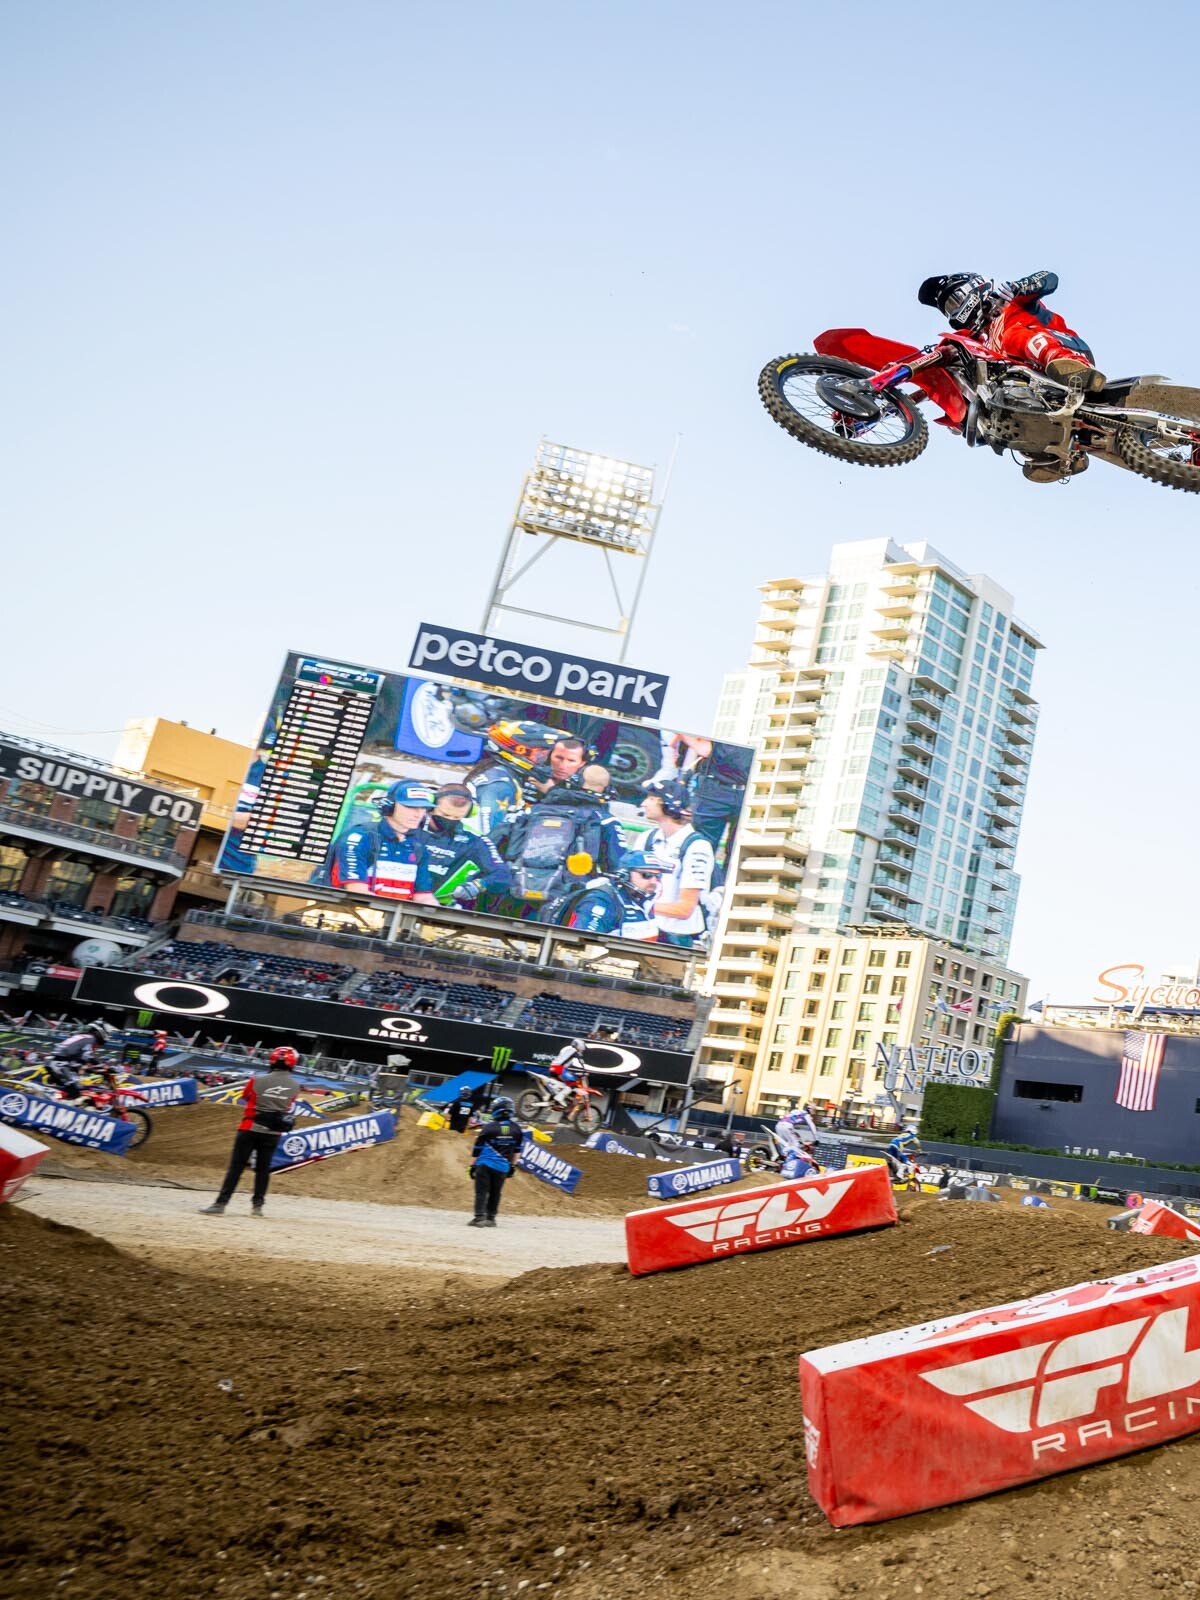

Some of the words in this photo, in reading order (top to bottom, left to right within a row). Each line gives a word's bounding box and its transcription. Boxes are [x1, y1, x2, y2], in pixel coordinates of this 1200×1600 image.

[412, 631, 552, 683] petco
[554, 662, 663, 708] park
[15, 756, 143, 808] SUPPLY
[148, 794, 197, 826] CO.
[368, 1027, 429, 1043] OAKLEY
[27, 1100, 116, 1143] YAMAHA
[305, 1118, 381, 1151] YAMAHA
[520, 1141, 574, 1182] YAMAHA
[686, 1163, 734, 1188] YAMAHA
[664, 1178, 856, 1243] FLY
[712, 1222, 823, 1253] RACING
